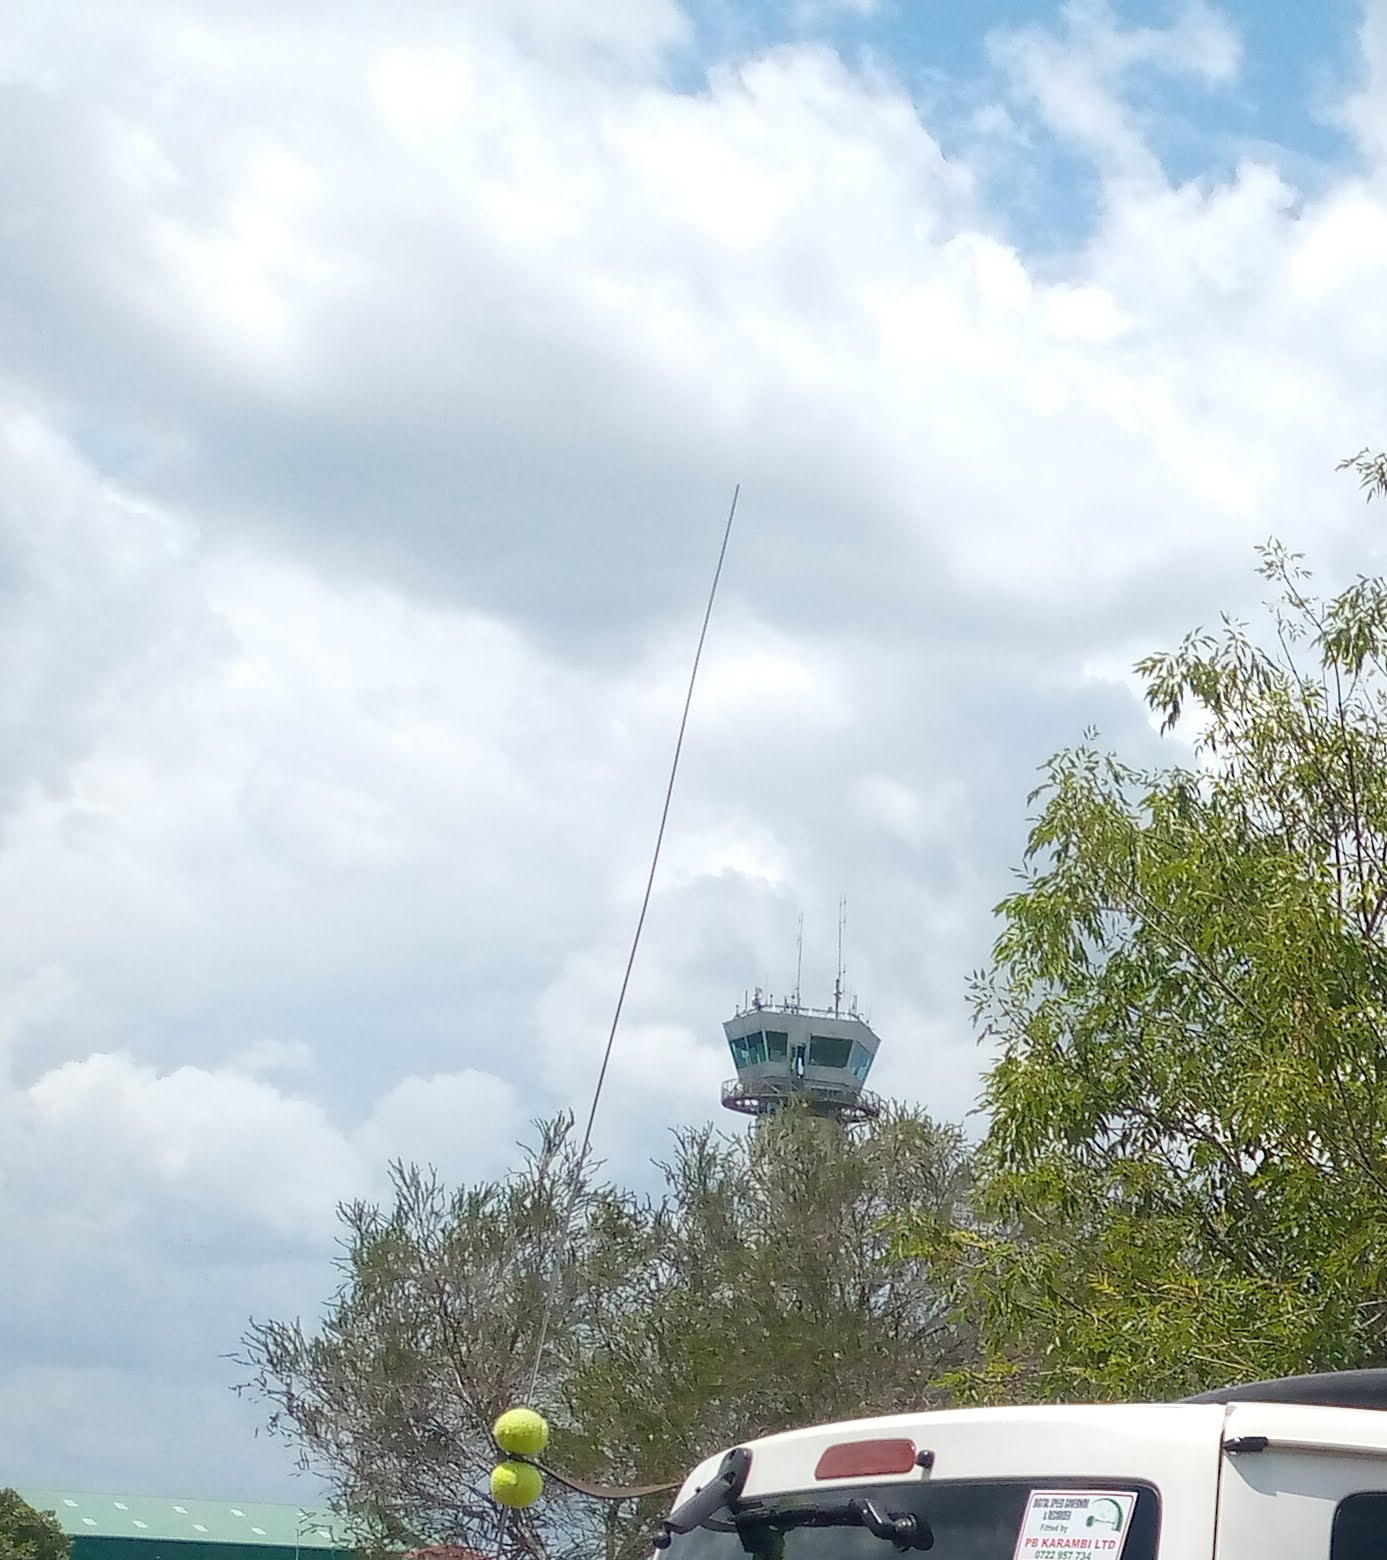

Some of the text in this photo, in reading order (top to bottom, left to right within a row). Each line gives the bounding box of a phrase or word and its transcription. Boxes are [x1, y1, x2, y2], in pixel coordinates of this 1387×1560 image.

[1040, 1524, 1068, 1534] Fitted by
[1025, 1538, 1116, 1550] PB KARAMBI LTD
[1034, 1551, 1055, 1560] 0722
